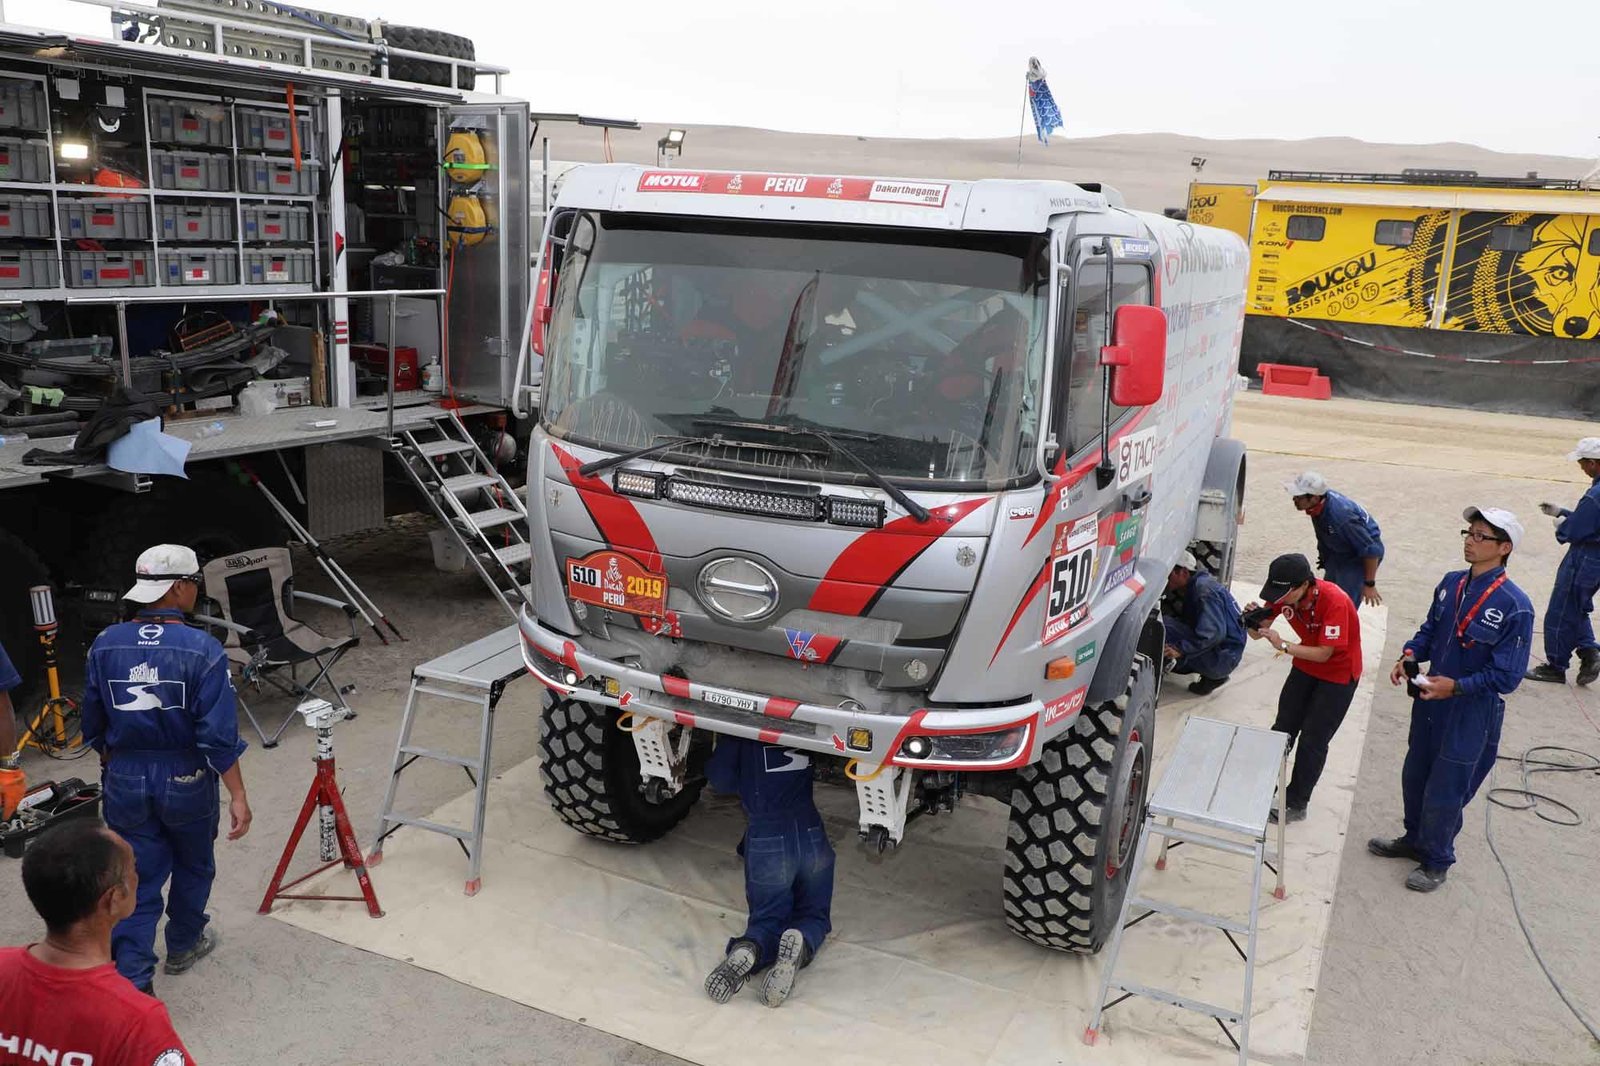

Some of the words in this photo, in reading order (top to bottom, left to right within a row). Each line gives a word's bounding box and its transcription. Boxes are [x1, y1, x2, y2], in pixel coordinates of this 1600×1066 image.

[644, 175, 701, 187] MOTUL
[876, 185, 941, 197] Dakarthegame
[1285, 252, 1377, 306] BOUCOU
[1288, 279, 1361, 315] ASSISTANCE
[572, 565, 597, 586] 510
[1049, 548, 1093, 618] 510
[627, 575, 662, 599] 2019
[603, 591, 625, 606] PERÚ
[1481, 619, 1500, 629] HINO
[711, 692, 731, 706] 6790
